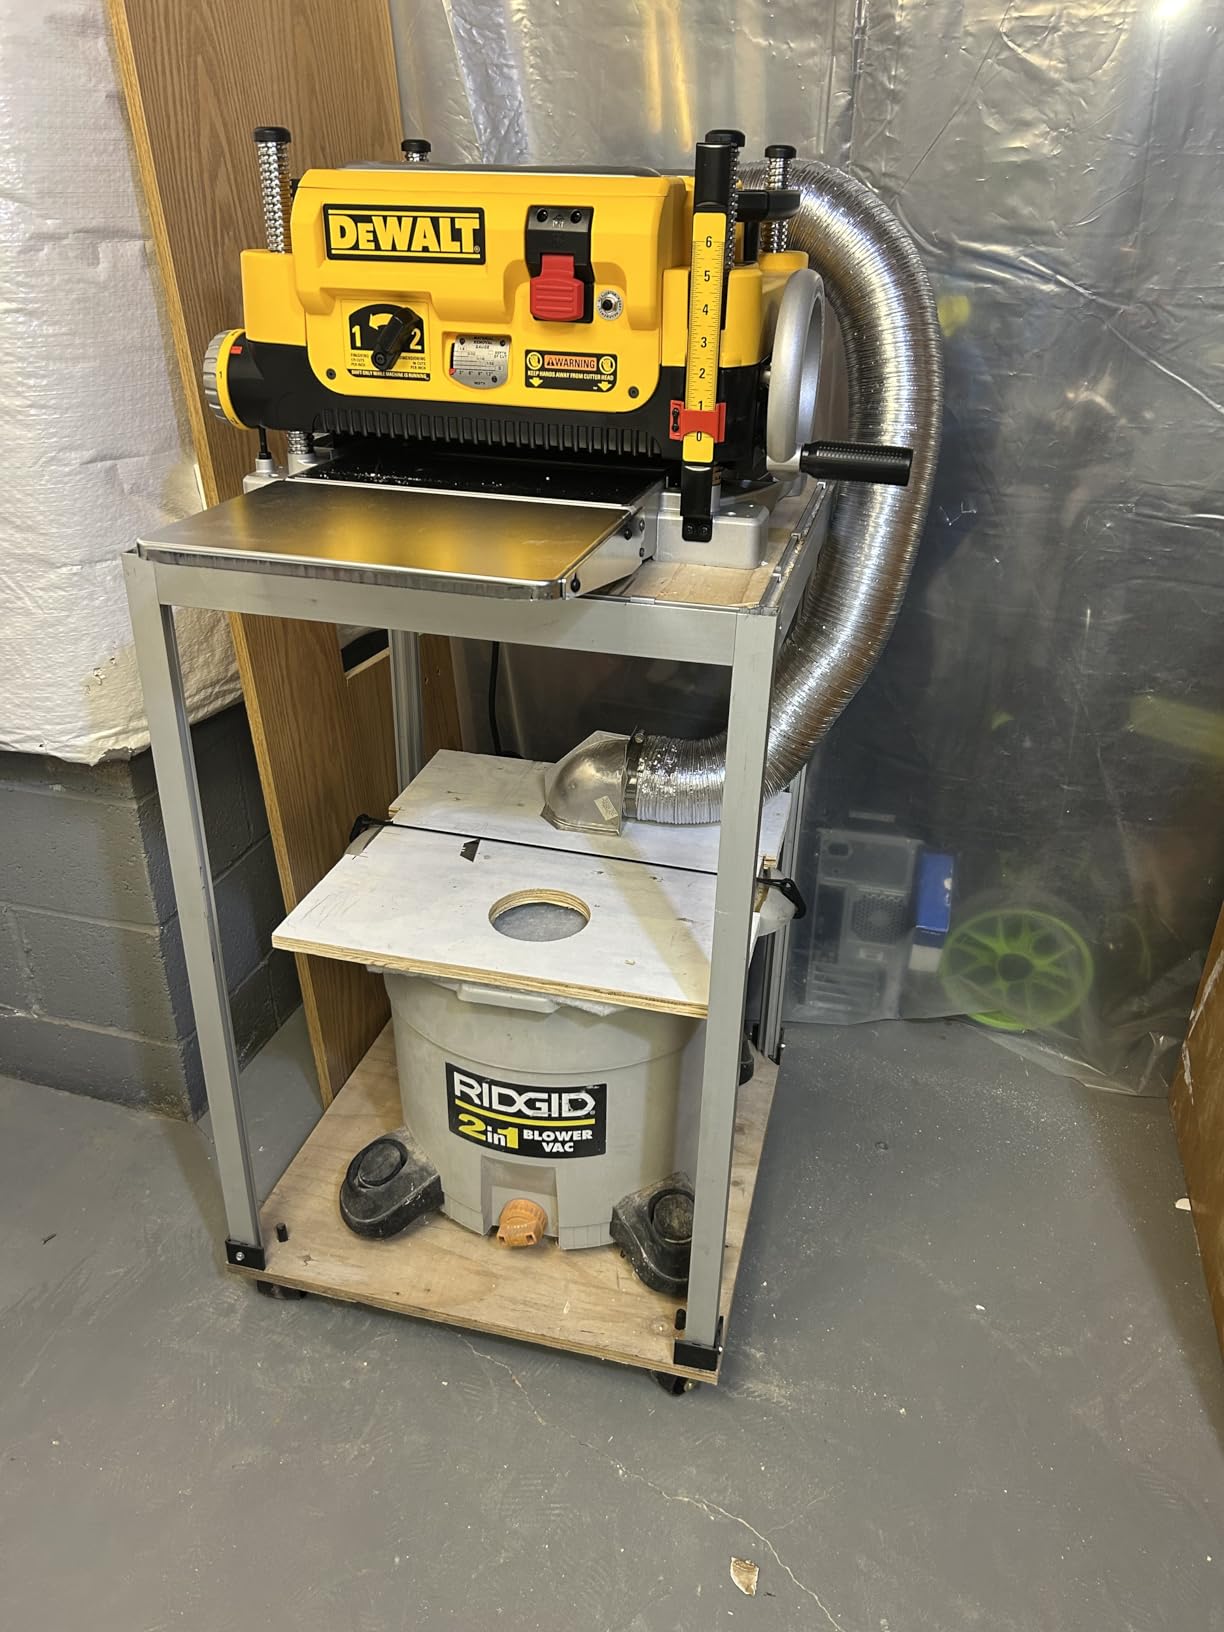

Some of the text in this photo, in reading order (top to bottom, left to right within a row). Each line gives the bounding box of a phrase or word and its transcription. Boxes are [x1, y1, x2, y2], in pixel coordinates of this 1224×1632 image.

[328, 214, 480, 253] DEWALT
[705, 236, 712, 248] 6
[704, 270, 711, 282] 5
[702, 304, 709, 315] 4
[352, 325, 361, 347] 1
[410, 328, 422, 350] 2
[700, 336, 707, 348] 3
[554, 357, 596, 369] WARNING
[699, 368, 706, 379] 2
[698, 400, 703, 411] 1
[696, 431, 702, 442] 0
[453, 1071, 596, 1118] RIDGID
[523, 1129, 593, 1141] BLOWER
[542, 1142, 574, 1153] VAC
